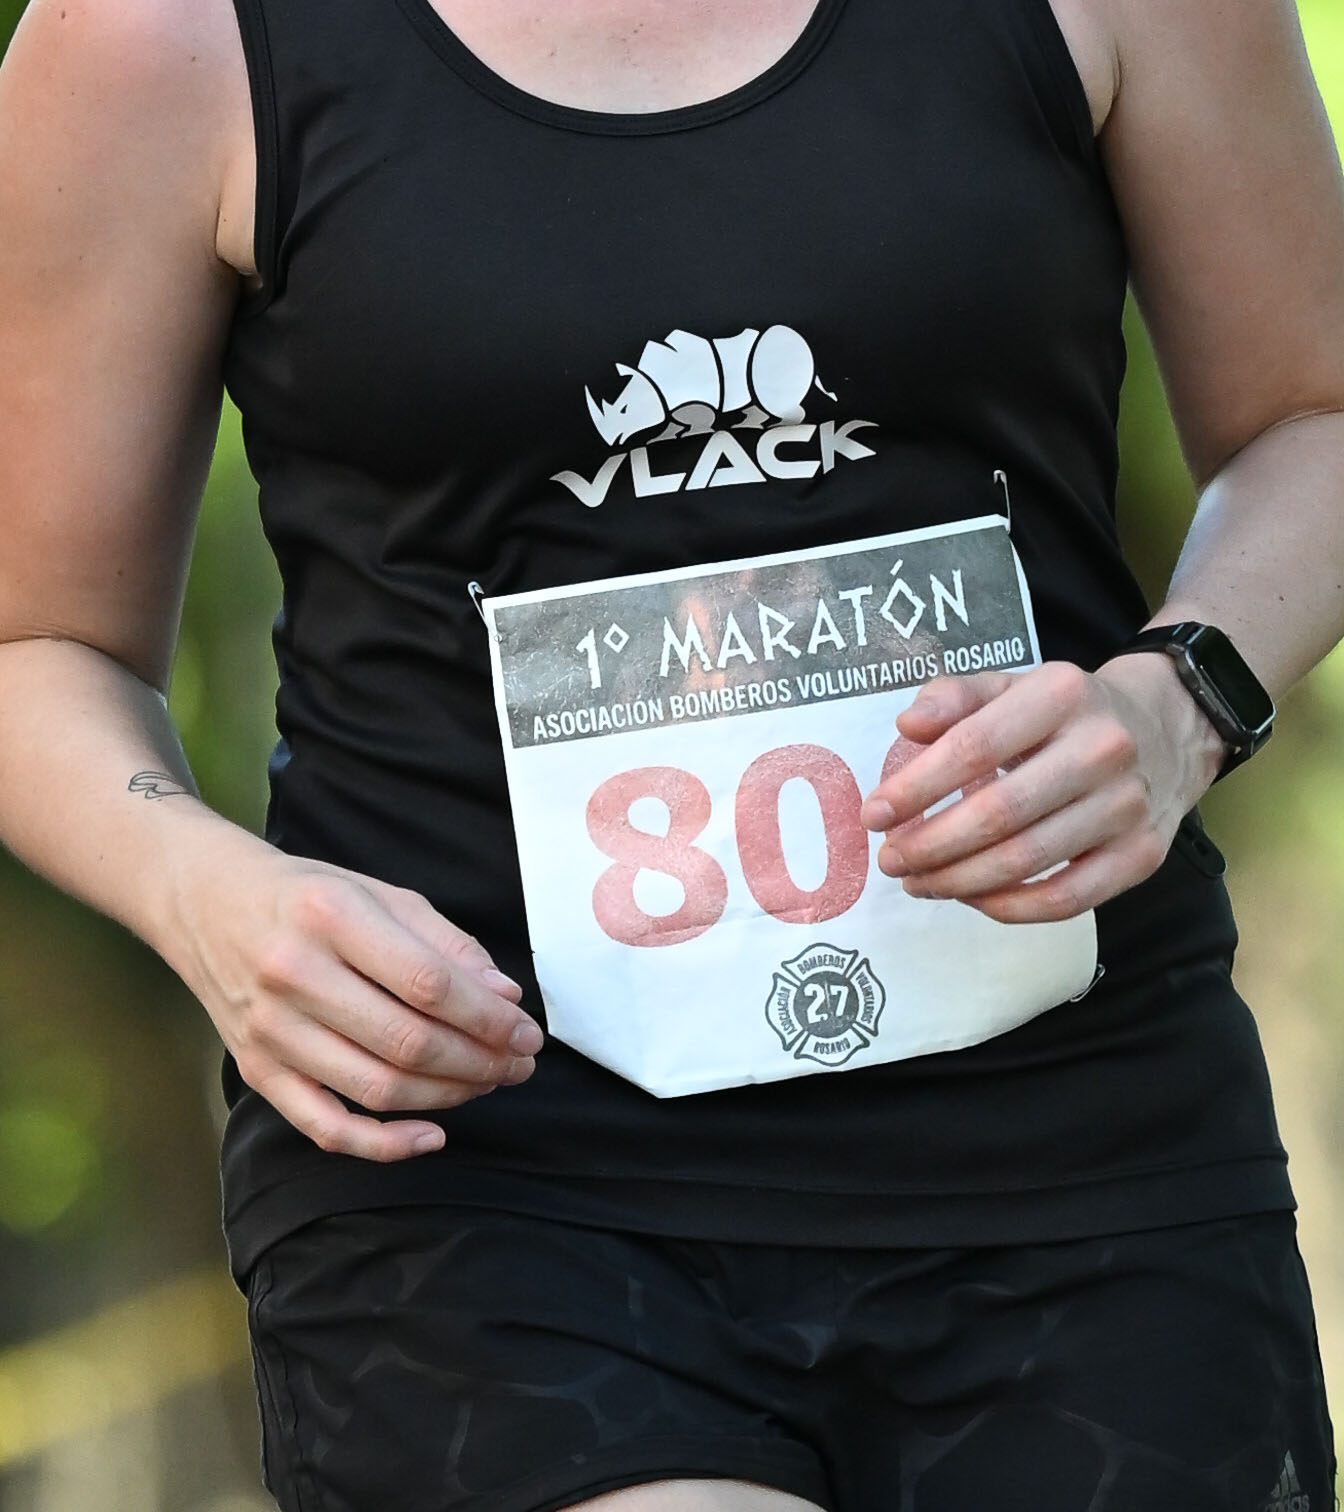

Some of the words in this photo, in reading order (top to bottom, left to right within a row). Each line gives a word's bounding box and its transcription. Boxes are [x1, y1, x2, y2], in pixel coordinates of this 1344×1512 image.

[549, 419, 880, 508] VLACK
[659, 558, 970, 678] MARATÓN
[532, 693, 665, 741] ASOCIACIÓN
[669, 677, 793, 720] BOMBEROS
[796, 652, 939, 700] VOLUNTARIOS
[942, 636, 1025, 675] ROSARIO
[797, 954, 846, 974] BOMBEROS
[803, 982, 849, 1025] 27
[856, 972, 875, 1024] VOLUNTARIOS
[813, 1037, 850, 1055] ROSARIO
